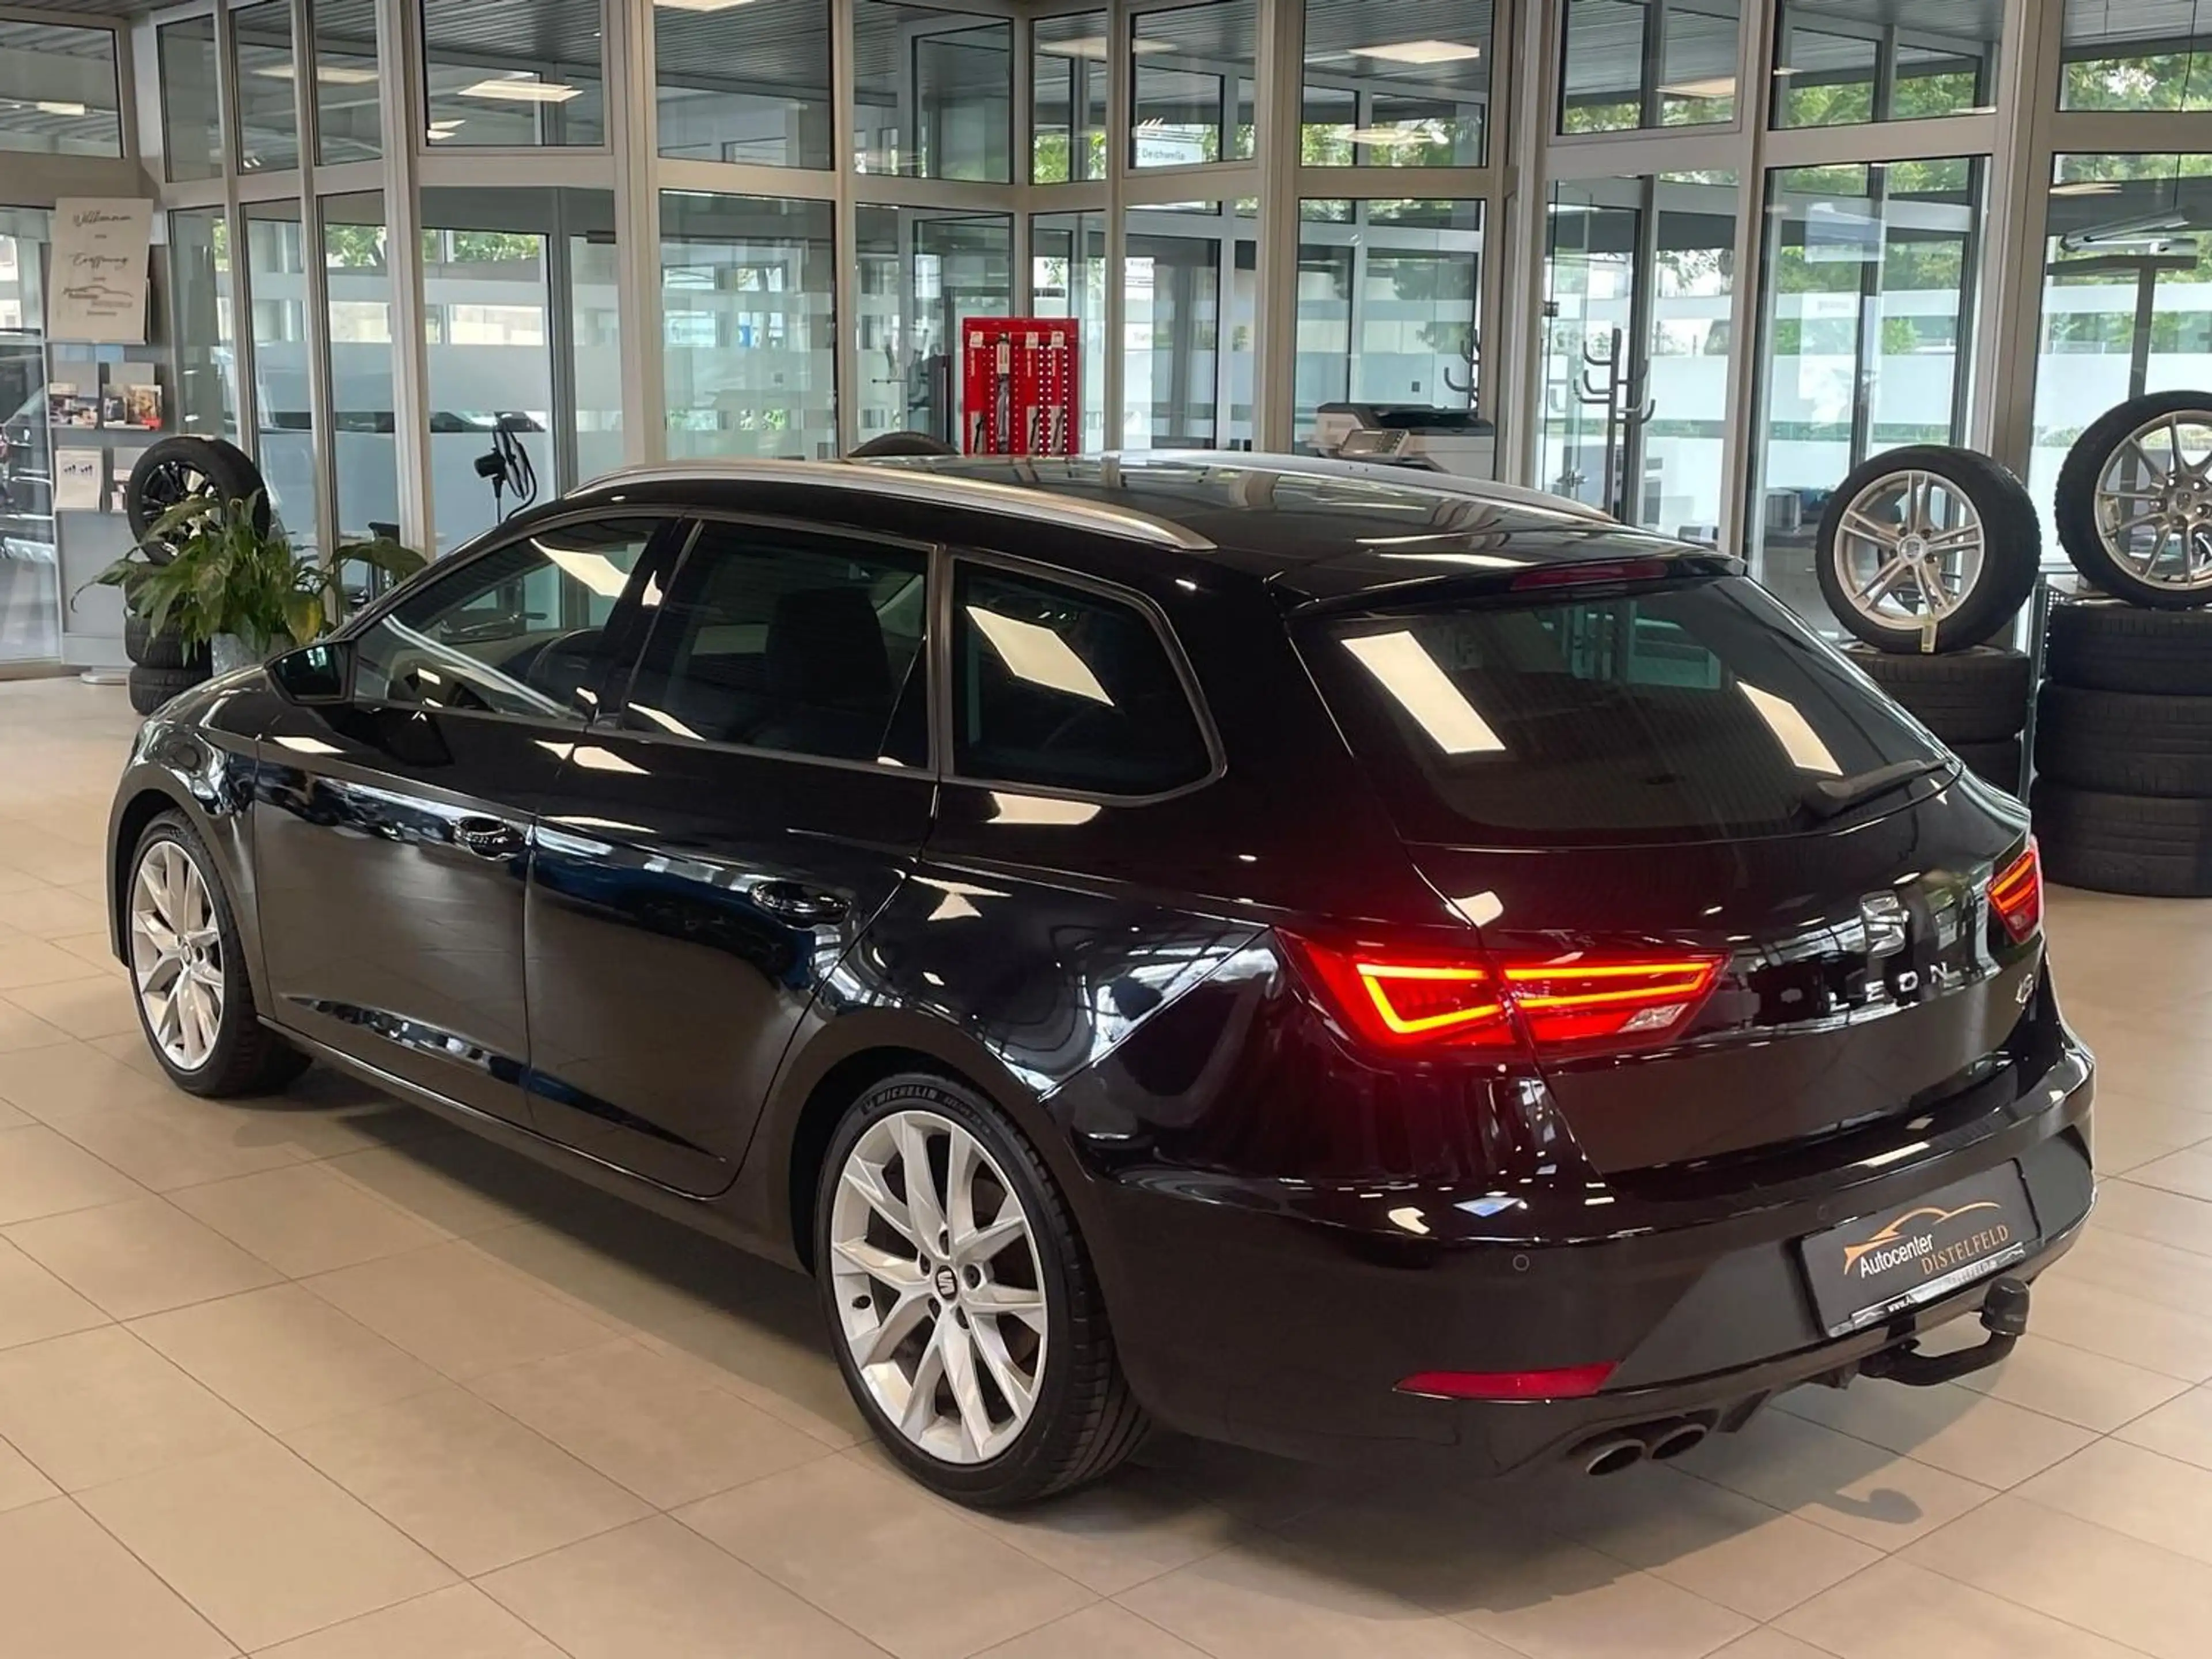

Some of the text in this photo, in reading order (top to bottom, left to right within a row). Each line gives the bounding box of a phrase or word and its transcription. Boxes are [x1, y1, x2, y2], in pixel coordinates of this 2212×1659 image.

[1828, 961, 1949, 1012] LEON
[1860, 1234, 1934, 1279] Autocenter
[1921, 1225, 2009, 1275] DISTELFELD
